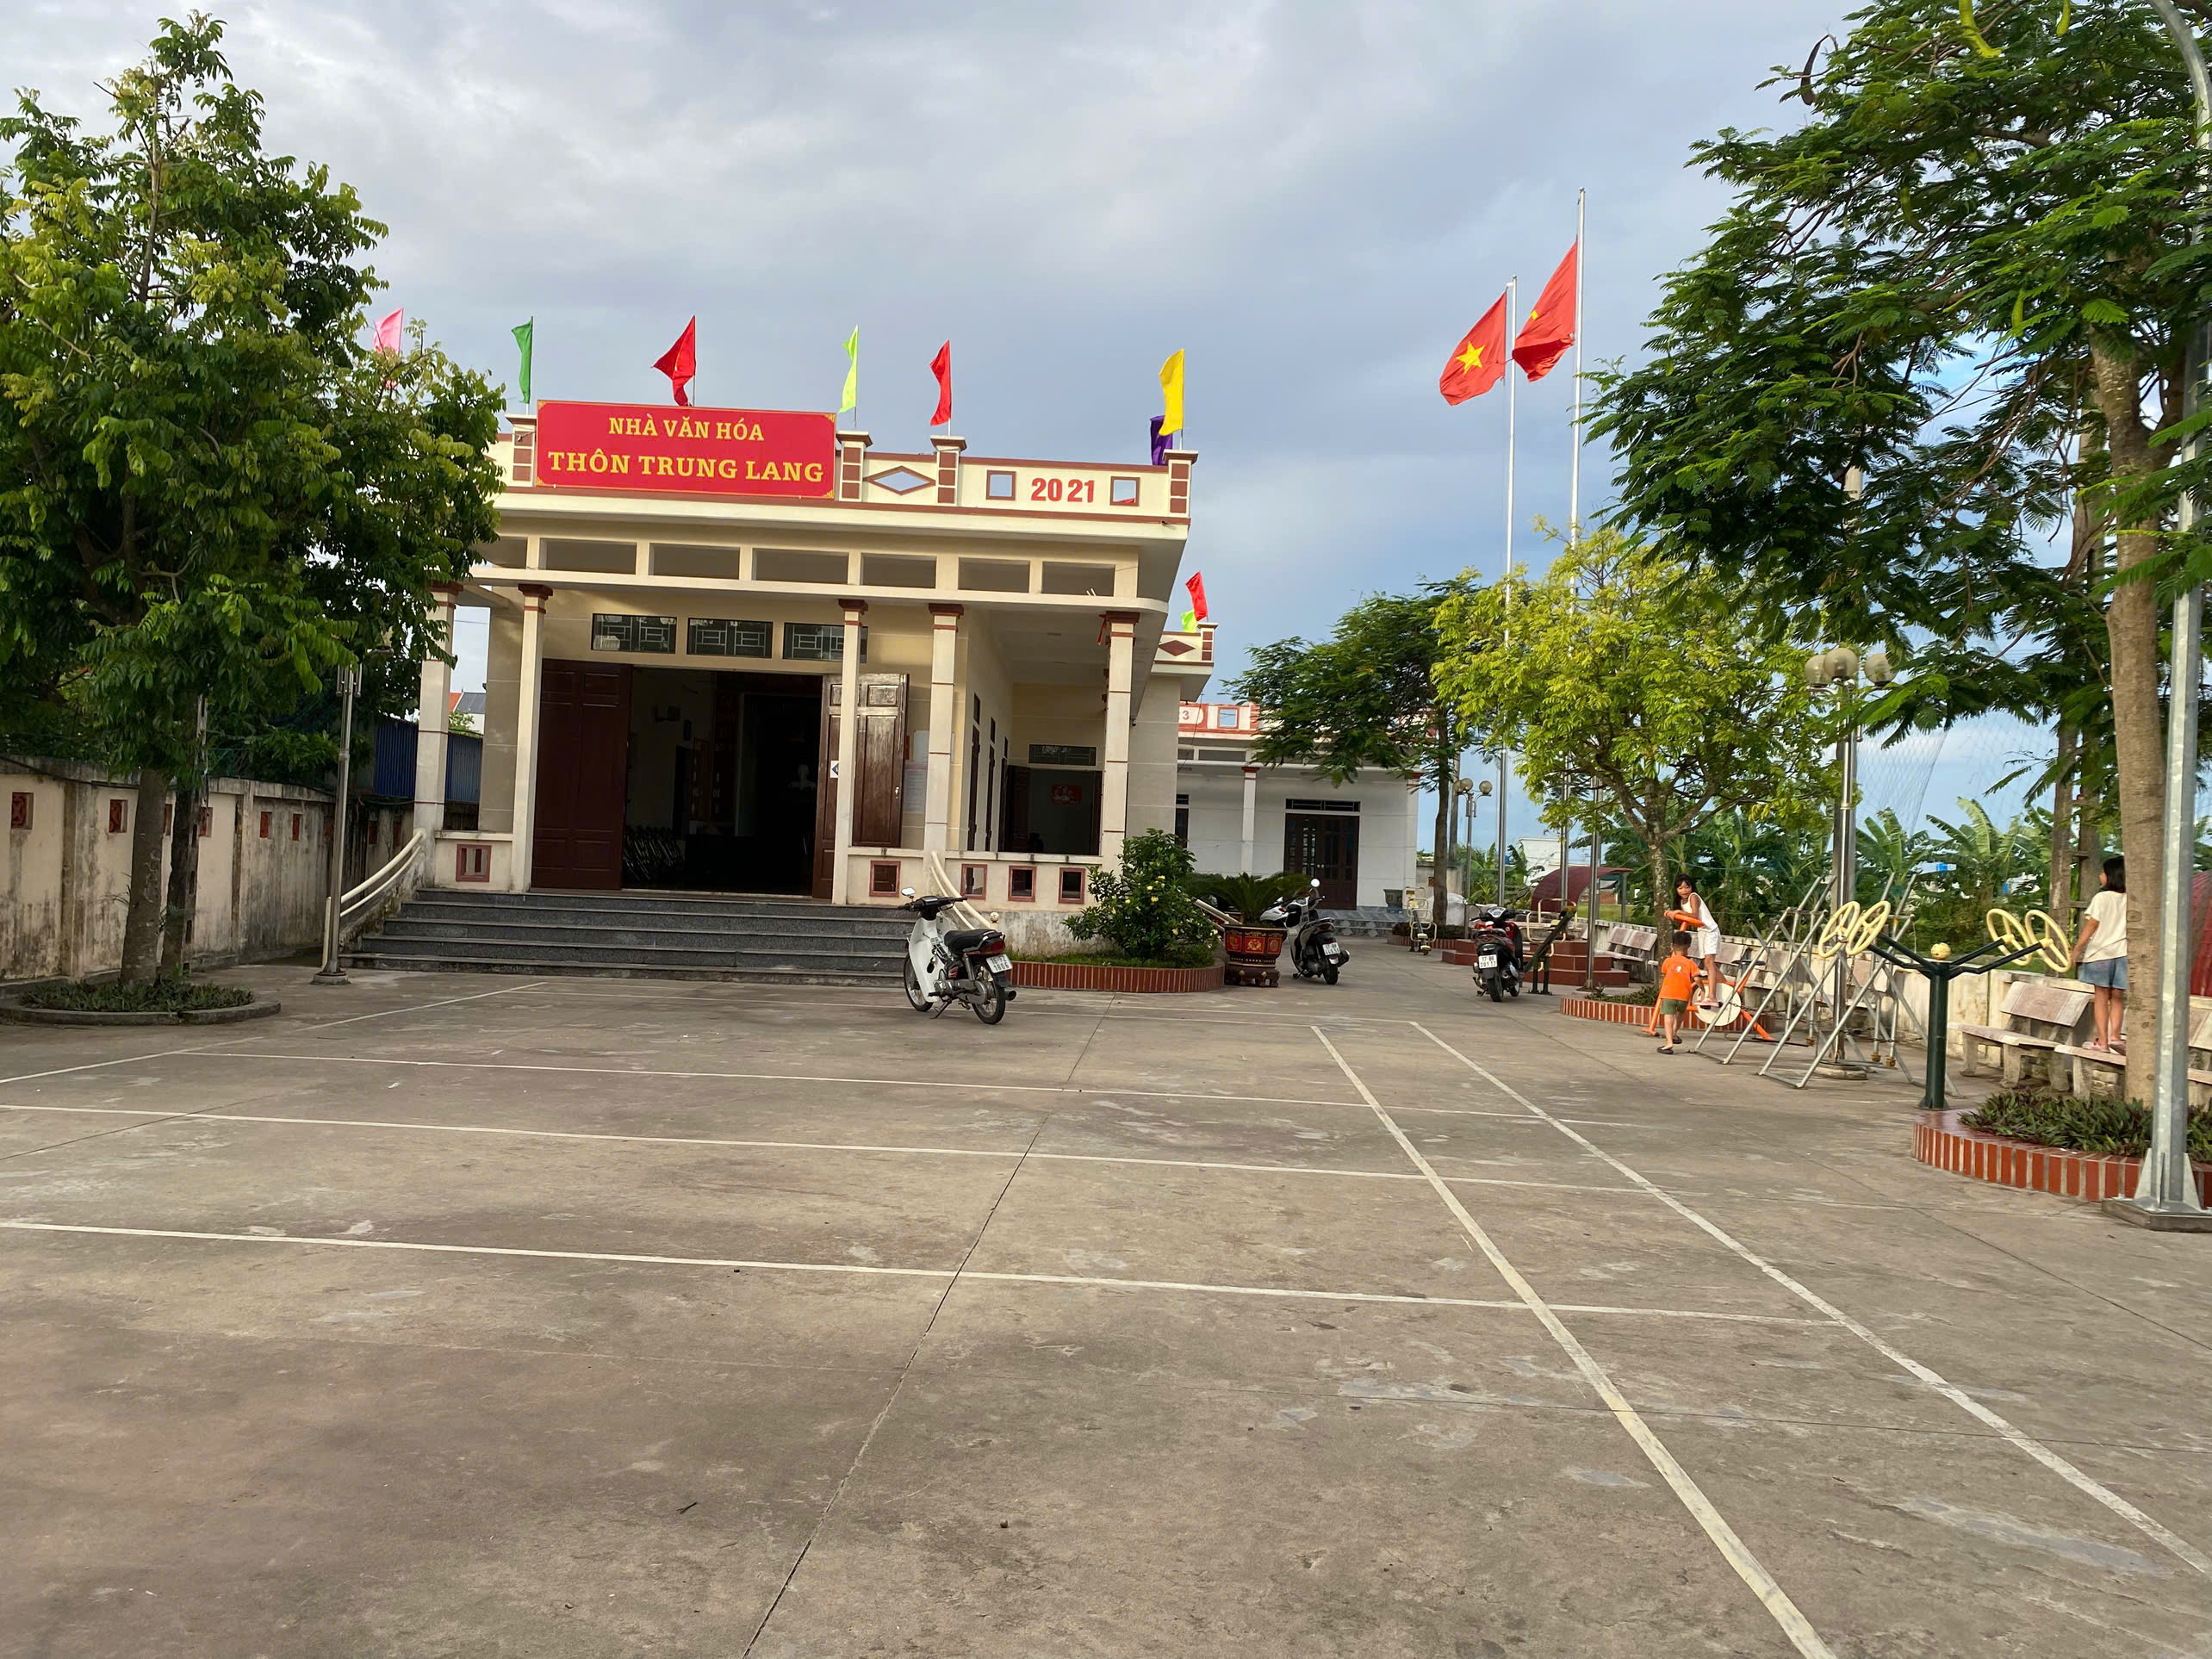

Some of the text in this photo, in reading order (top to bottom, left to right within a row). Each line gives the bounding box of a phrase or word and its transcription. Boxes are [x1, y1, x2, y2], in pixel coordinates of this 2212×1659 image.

[609, 413, 765, 442] NHÀ VĂN HÓA
[548, 448, 824, 483] THÔN TRUNG LANG
[1030, 477, 1095, 503] 2021
